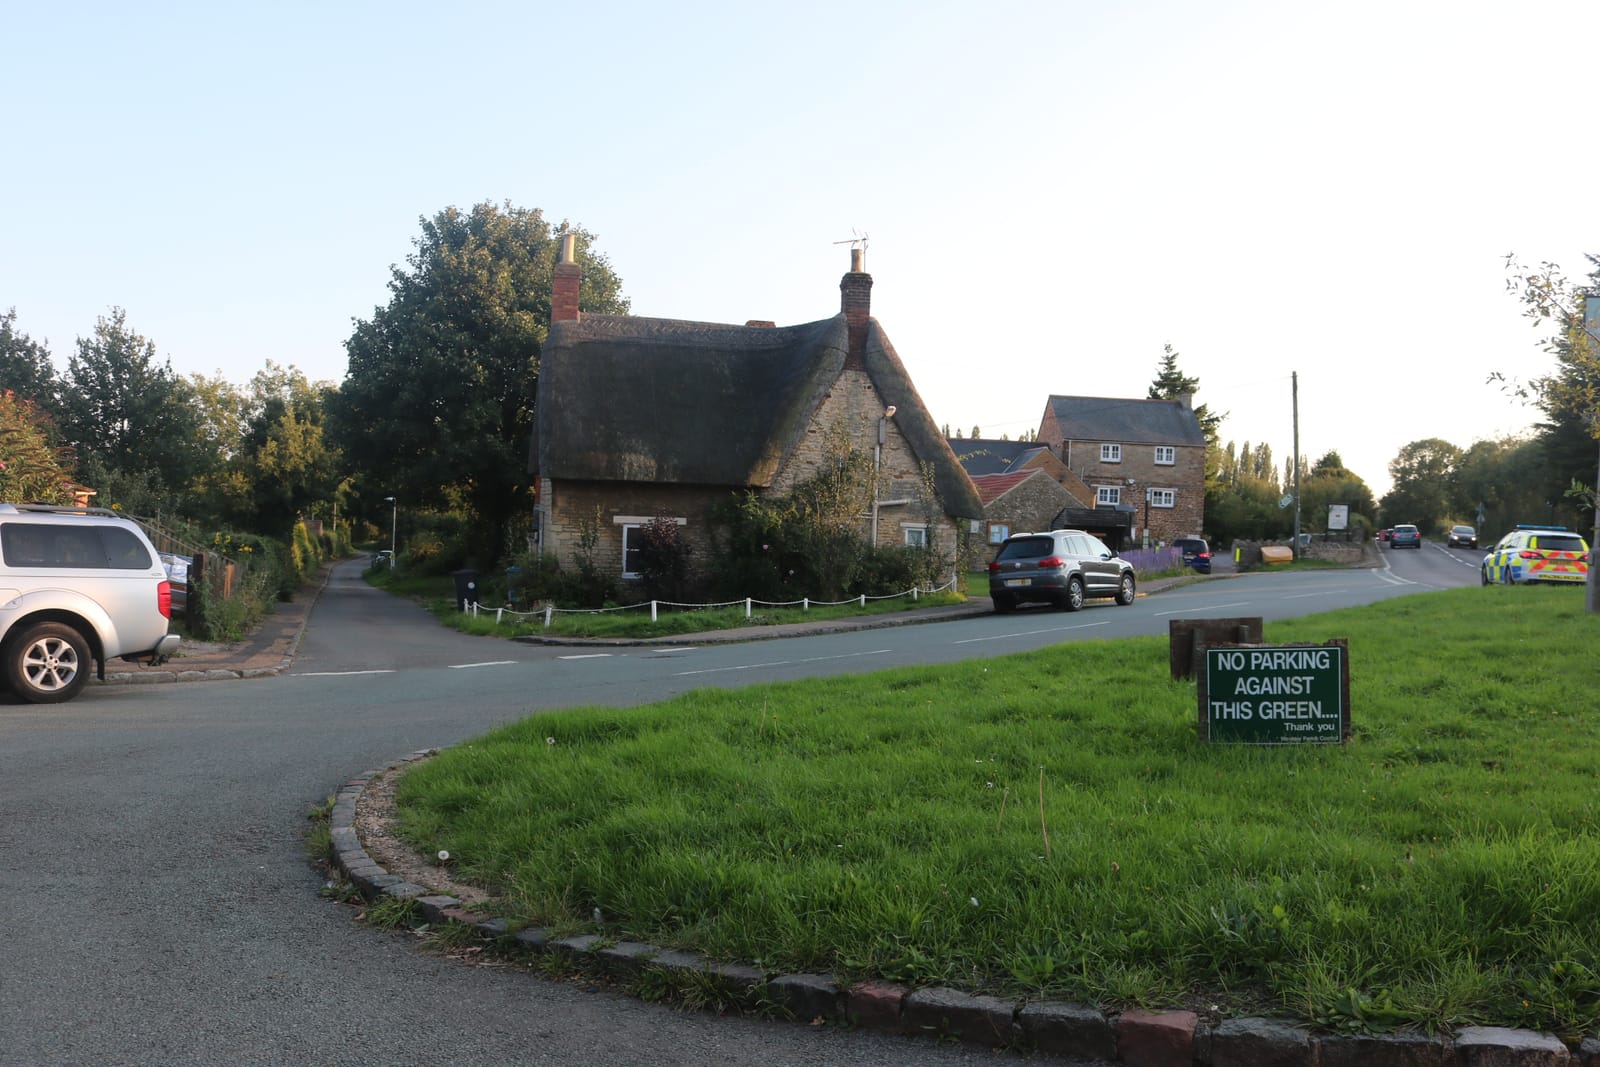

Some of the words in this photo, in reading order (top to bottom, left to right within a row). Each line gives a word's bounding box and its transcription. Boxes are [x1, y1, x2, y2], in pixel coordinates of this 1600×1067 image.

[1218, 652, 1245, 671] NO
[1251, 651, 1330, 670] PARKING
[1234, 676, 1314, 695] AGAINST
[1211, 701, 1253, 720] THIS
[1284, 722, 1314, 731] Thank
[1317, 723, 1335, 732] you
